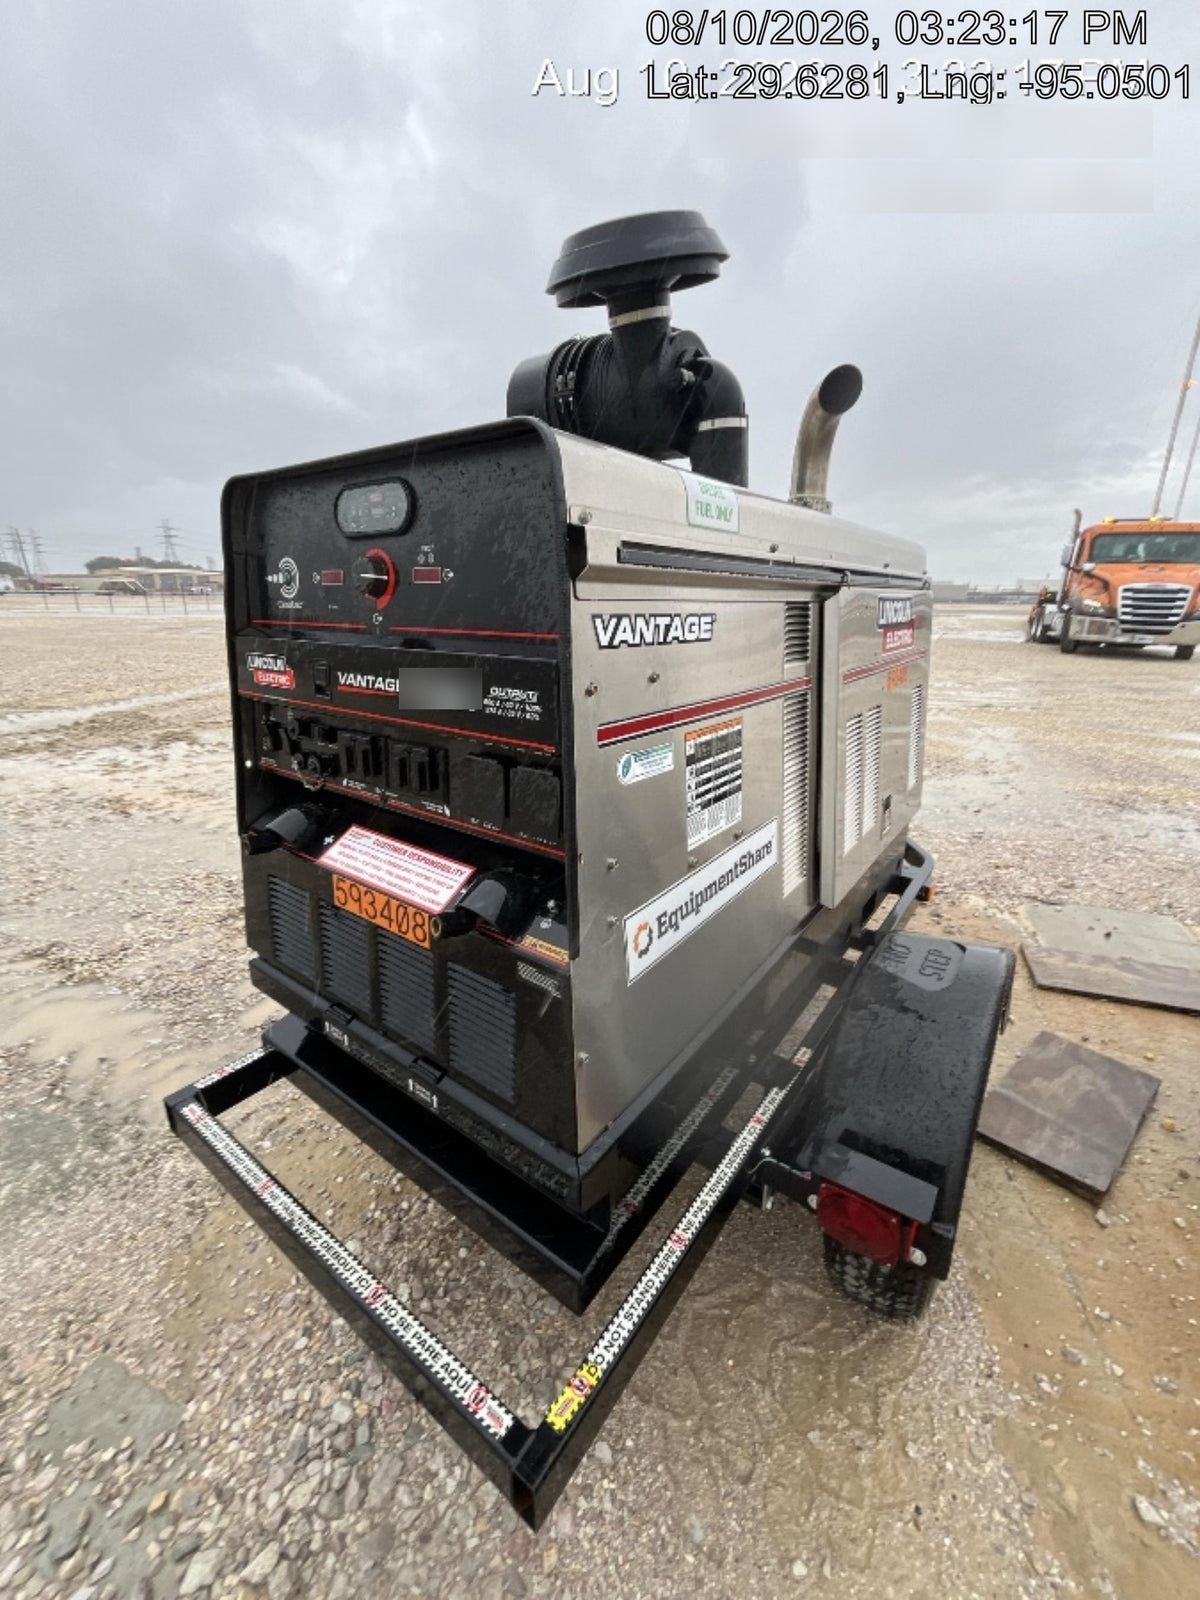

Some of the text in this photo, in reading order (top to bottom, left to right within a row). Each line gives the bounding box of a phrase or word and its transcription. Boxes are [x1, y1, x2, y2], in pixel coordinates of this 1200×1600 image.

[591, 613, 714, 649] VANTAGE
[247, 655, 285, 671] LINCOLN
[258, 670, 291, 686] ELECTRIC
[490, 686, 537, 700] OUTPUT
[335, 876, 427, 943] 593408
[655, 840, 773, 939] EquipmentShare
[919, 949, 952, 980] STEP
[295, 1216, 320, 1241] TENEZ
[319, 1239, 358, 1278] DEBOUT
[354, 1275, 371, 1291] ICI
[380, 1299, 398, 1318] NO
[396, 1315, 413, 1333] SE
[411, 1330, 443, 1363] PARE
[586, 1246, 677, 1377] DO NOT STAND HERE
